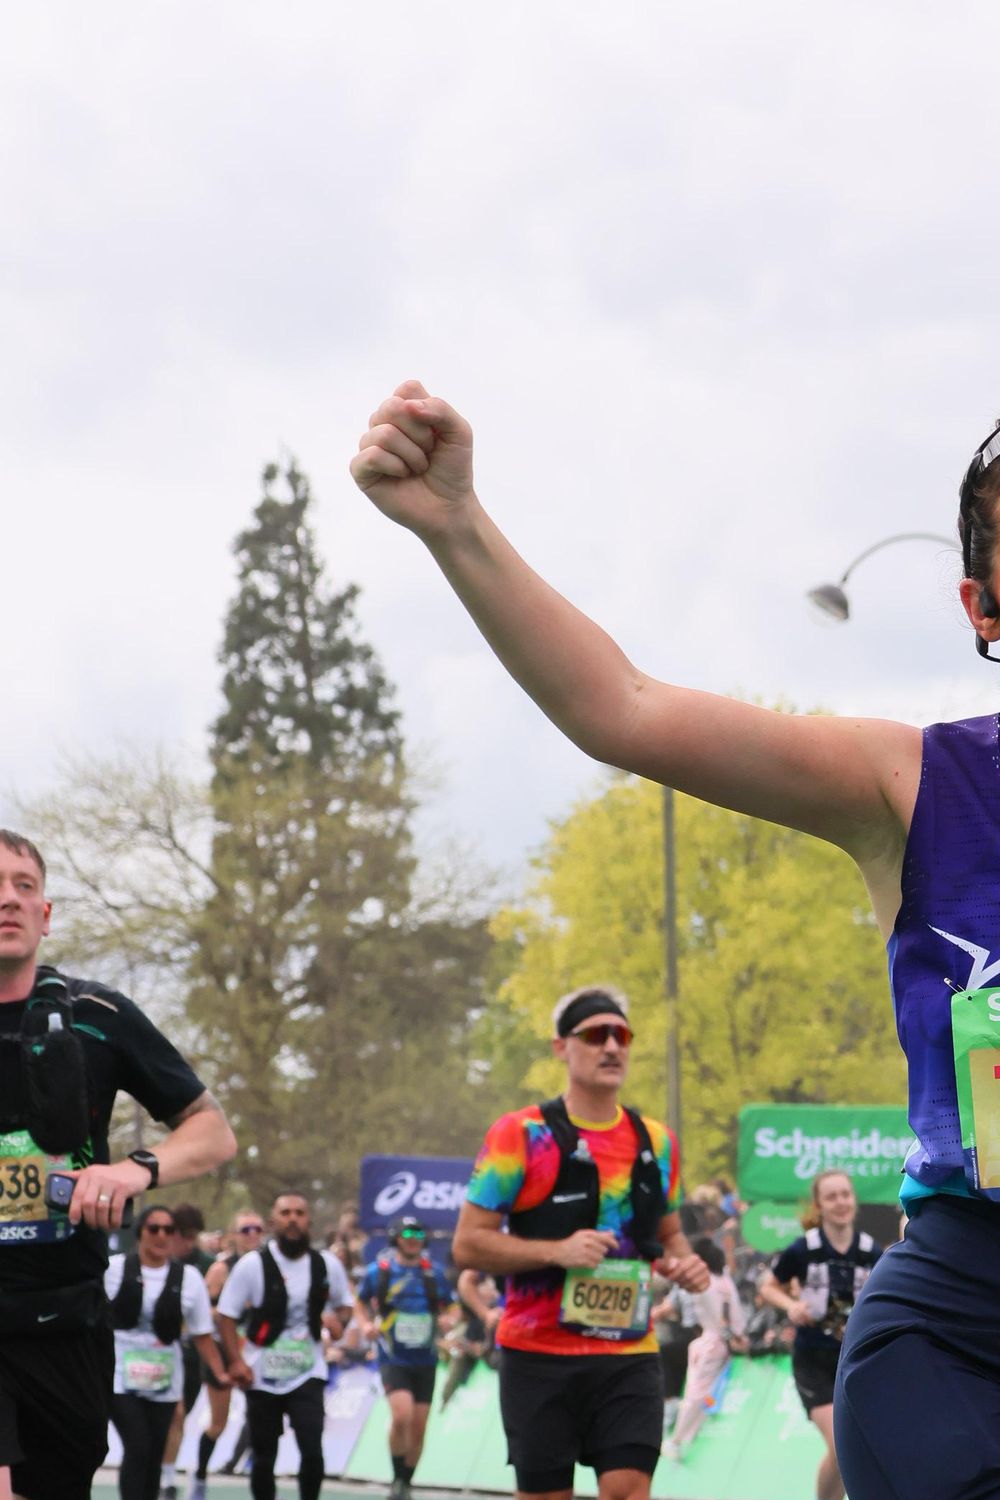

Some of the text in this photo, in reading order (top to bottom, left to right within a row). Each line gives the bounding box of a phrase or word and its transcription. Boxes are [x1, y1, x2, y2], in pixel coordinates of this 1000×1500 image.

[0, 1164, 41, 1199] 38
[413, 1180, 467, 1210] asi
[573, 1282, 632, 1312] 60218
